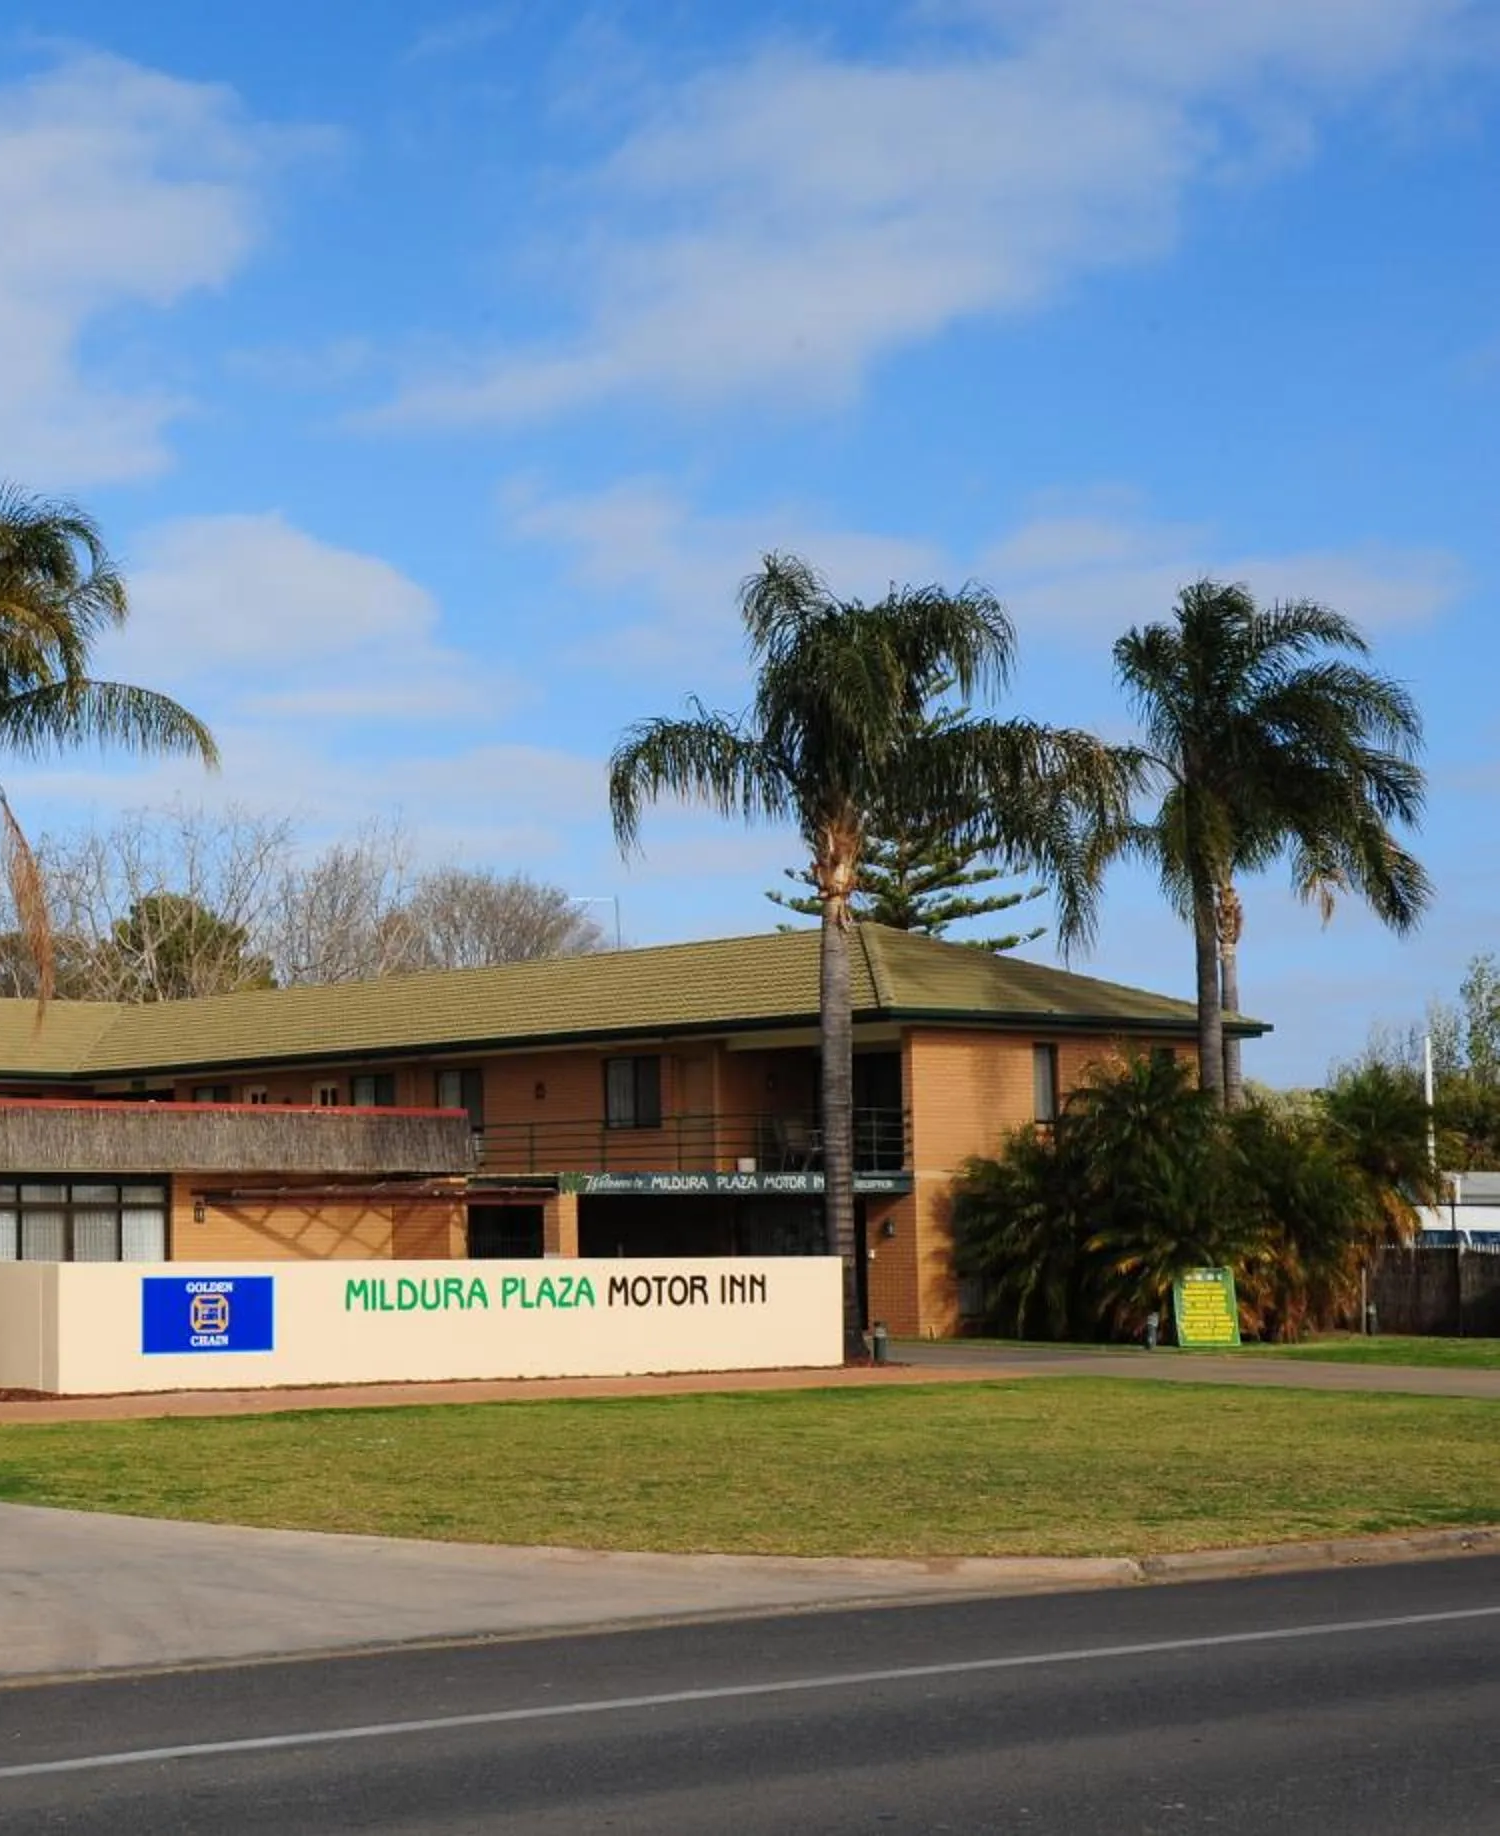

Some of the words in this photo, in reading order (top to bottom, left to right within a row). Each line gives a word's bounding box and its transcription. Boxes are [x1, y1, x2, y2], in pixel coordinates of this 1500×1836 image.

[651, 1175, 709, 1190] MILDURA
[716, 1175, 758, 1190] PLAZA
[763, 1175, 807, 1190] MOTOR
[185, 1281, 234, 1294] GOLDEN
[344, 1278, 489, 1312] MILDURA
[501, 1276, 596, 1310] PLAZA
[607, 1274, 709, 1308] MOTOR
[720, 1273, 767, 1304] INN
[190, 1335, 229, 1347] CHAIN
